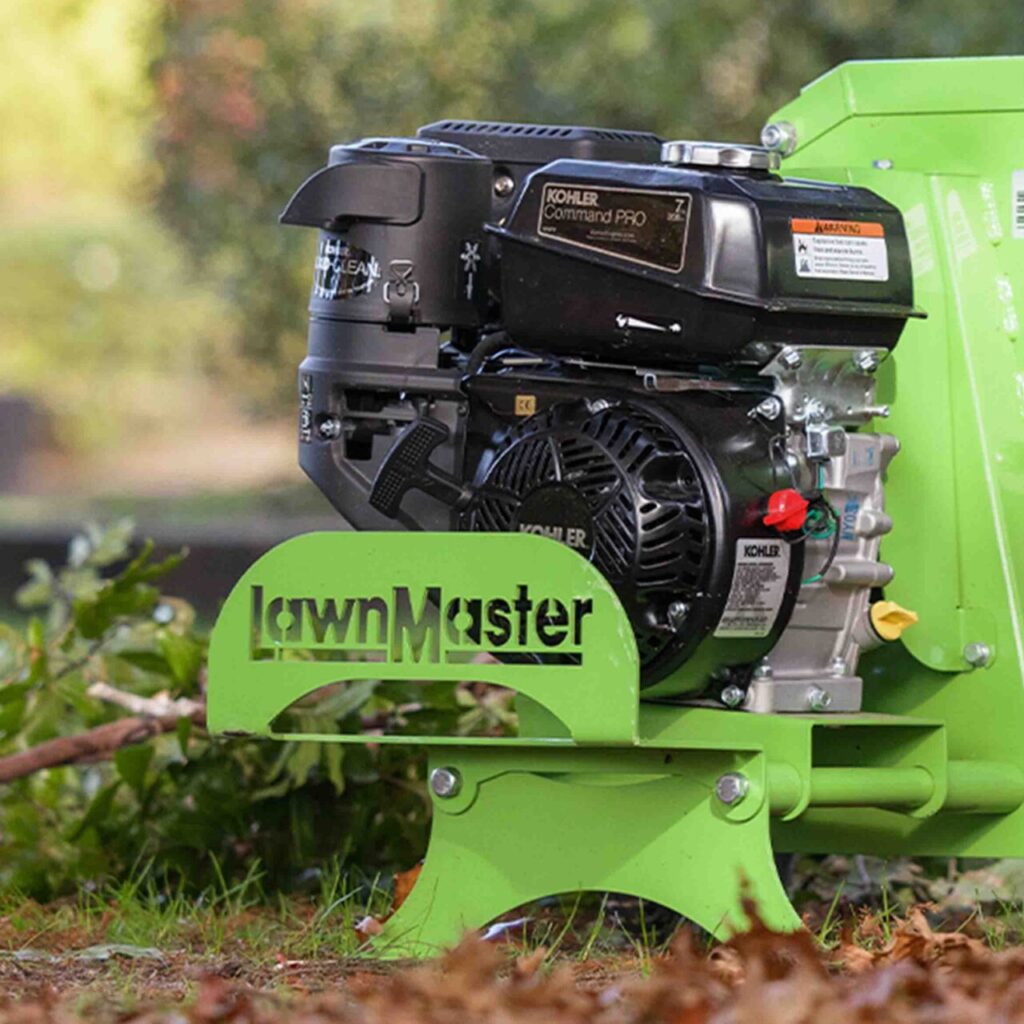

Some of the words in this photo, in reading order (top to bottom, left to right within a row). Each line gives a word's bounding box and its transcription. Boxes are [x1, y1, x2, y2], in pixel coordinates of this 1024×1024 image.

[546, 189, 599, 207] KOHLER
[674, 198, 686, 214] 7
[543, 204, 612, 224] Command
[614, 210, 647, 227] PRO
[744, 545, 781, 557] KOHLER
